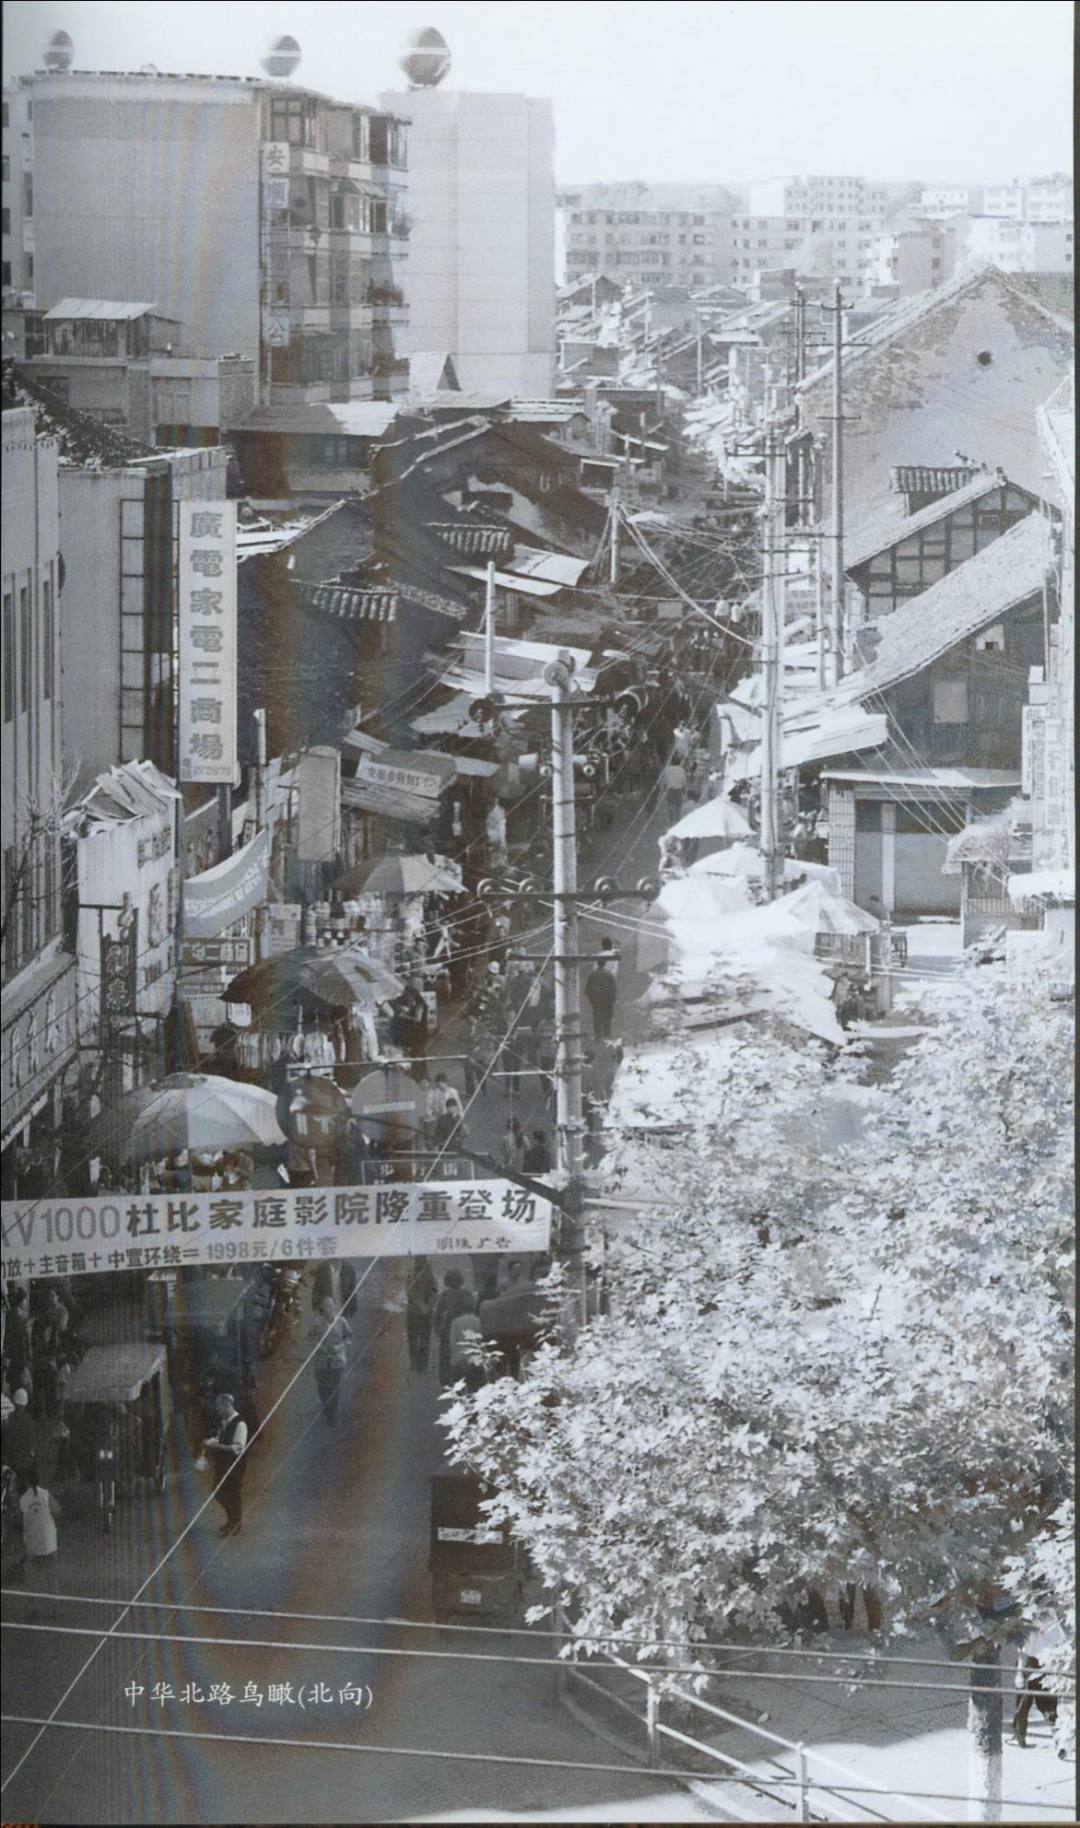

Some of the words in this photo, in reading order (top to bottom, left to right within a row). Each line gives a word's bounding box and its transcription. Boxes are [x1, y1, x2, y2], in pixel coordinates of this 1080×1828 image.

[190, 511, 223, 760] 廣電家電二商場
